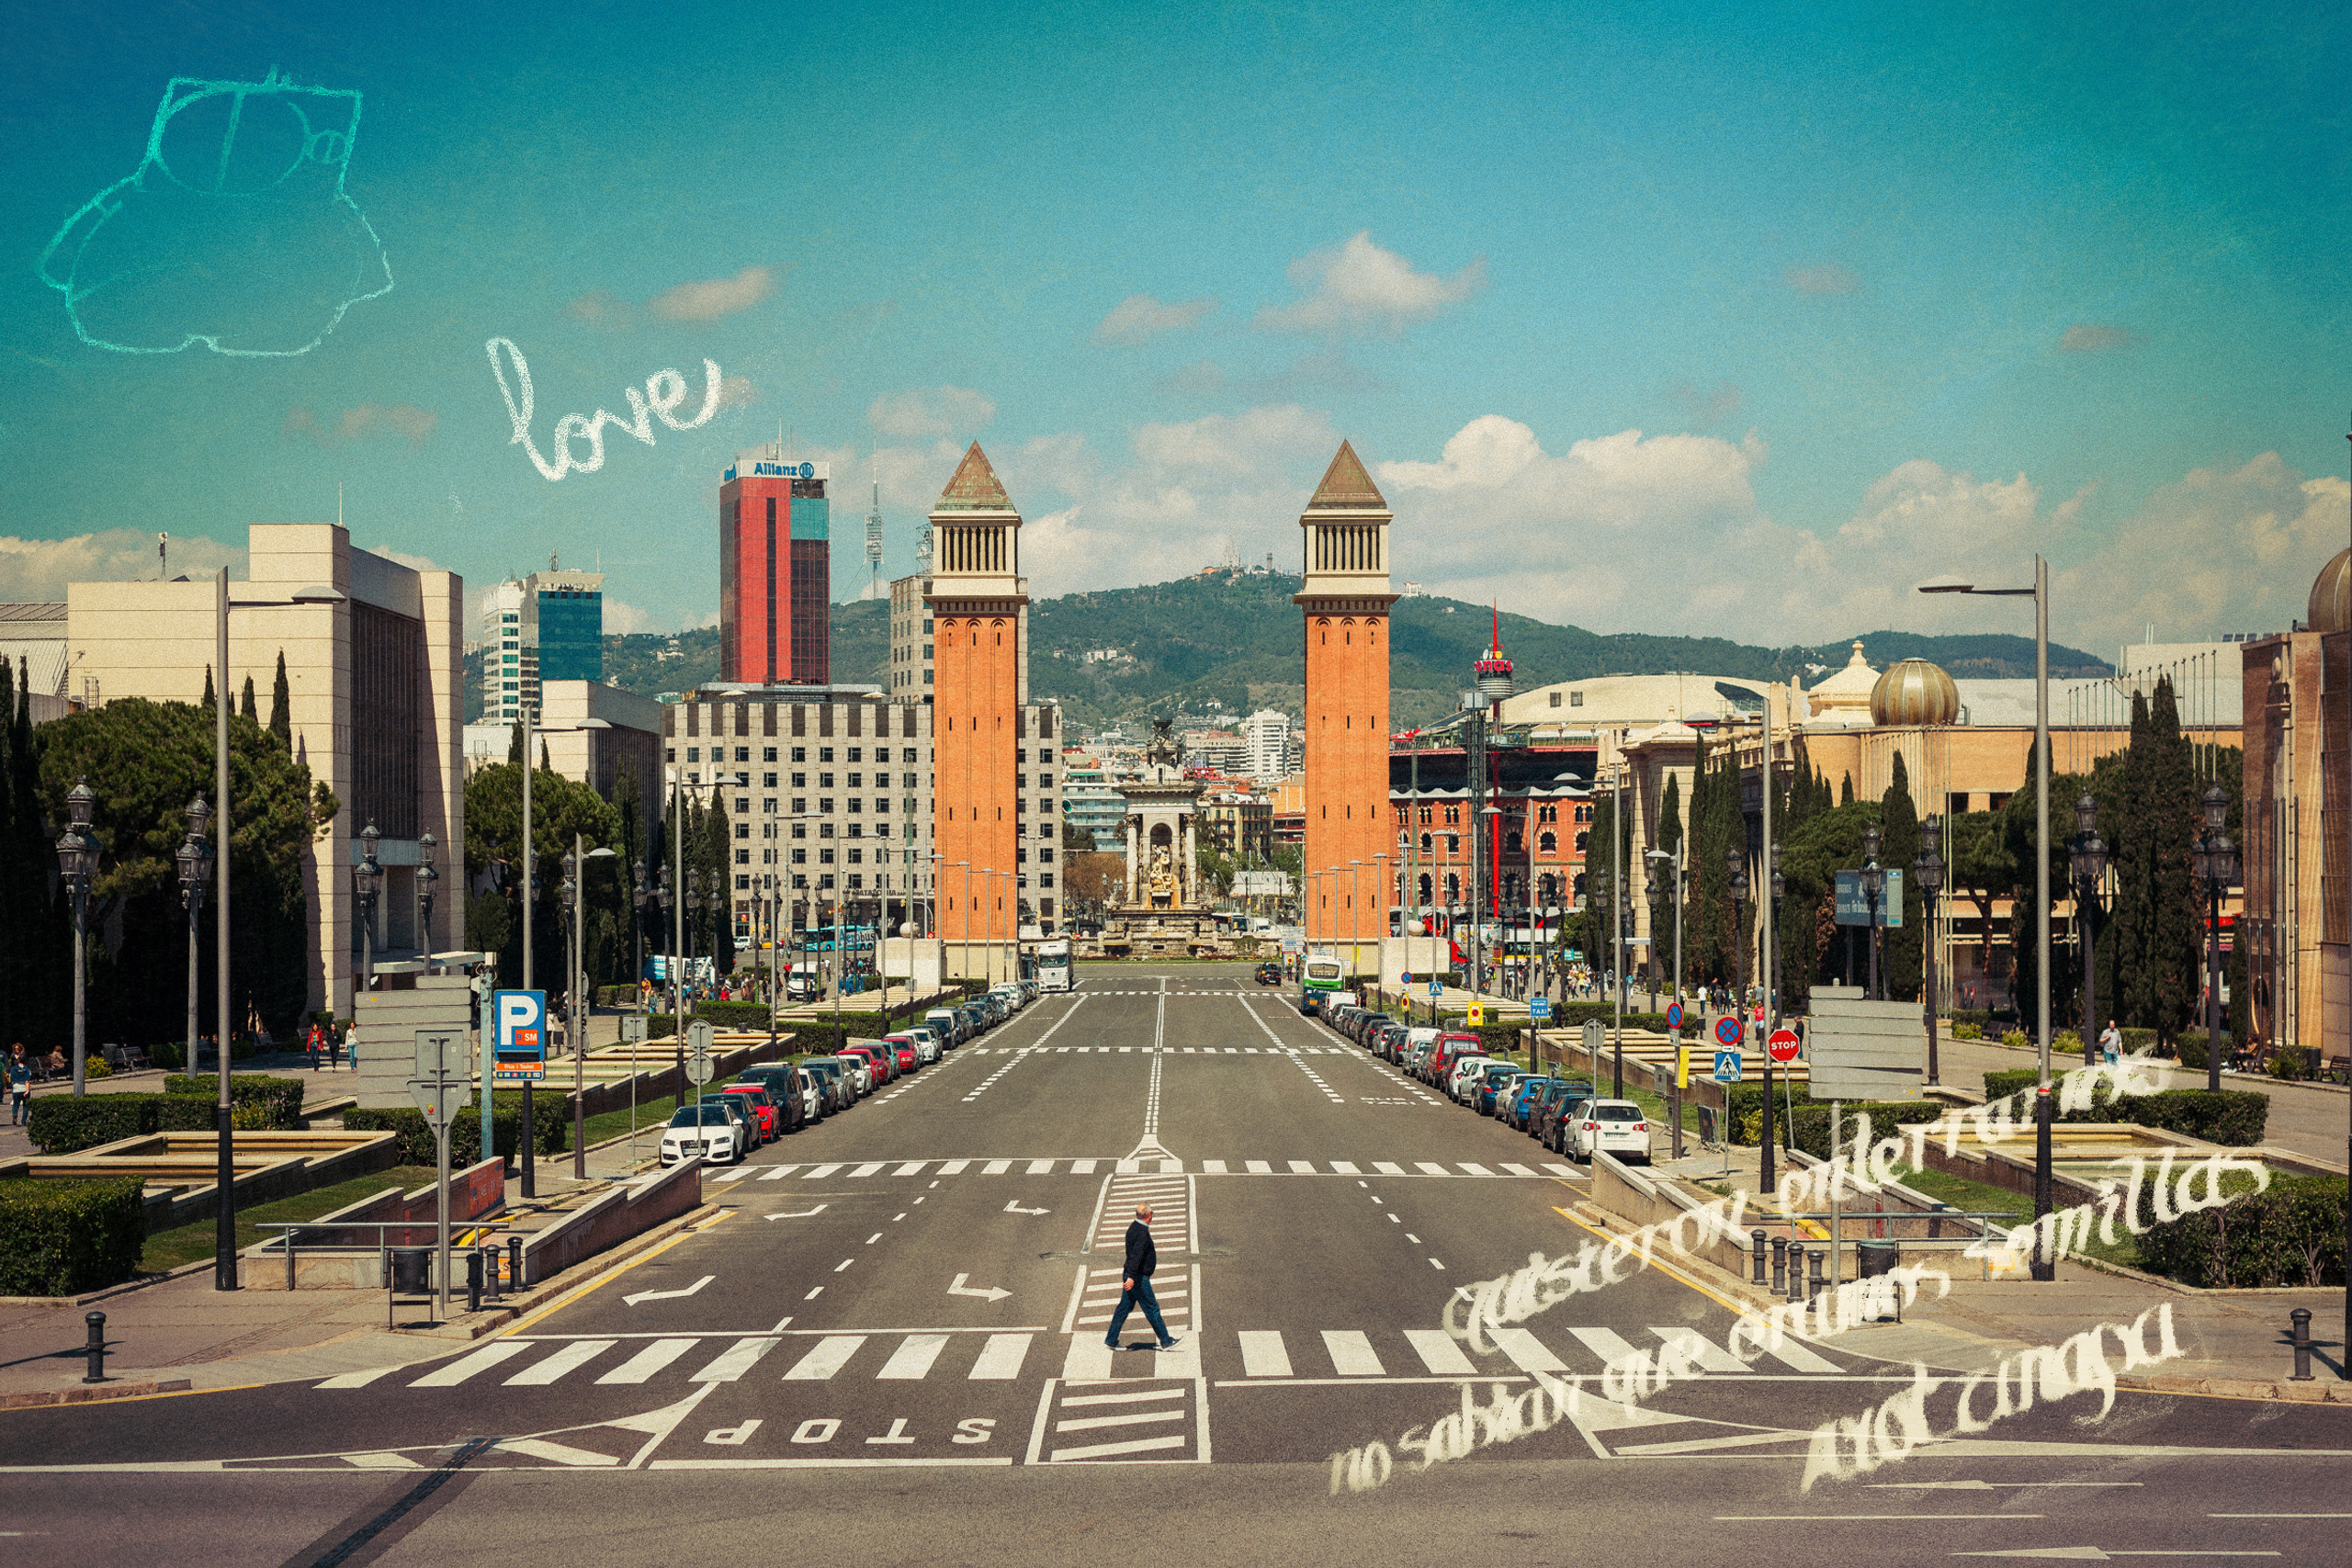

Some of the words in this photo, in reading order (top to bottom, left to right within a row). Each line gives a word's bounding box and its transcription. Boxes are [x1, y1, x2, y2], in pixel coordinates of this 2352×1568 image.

[754, 462, 797, 476] Allianz
[501, 995, 538, 1045] P
[1771, 1041, 1796, 1051] STOP
[703, 1419, 997, 1445] STOP
